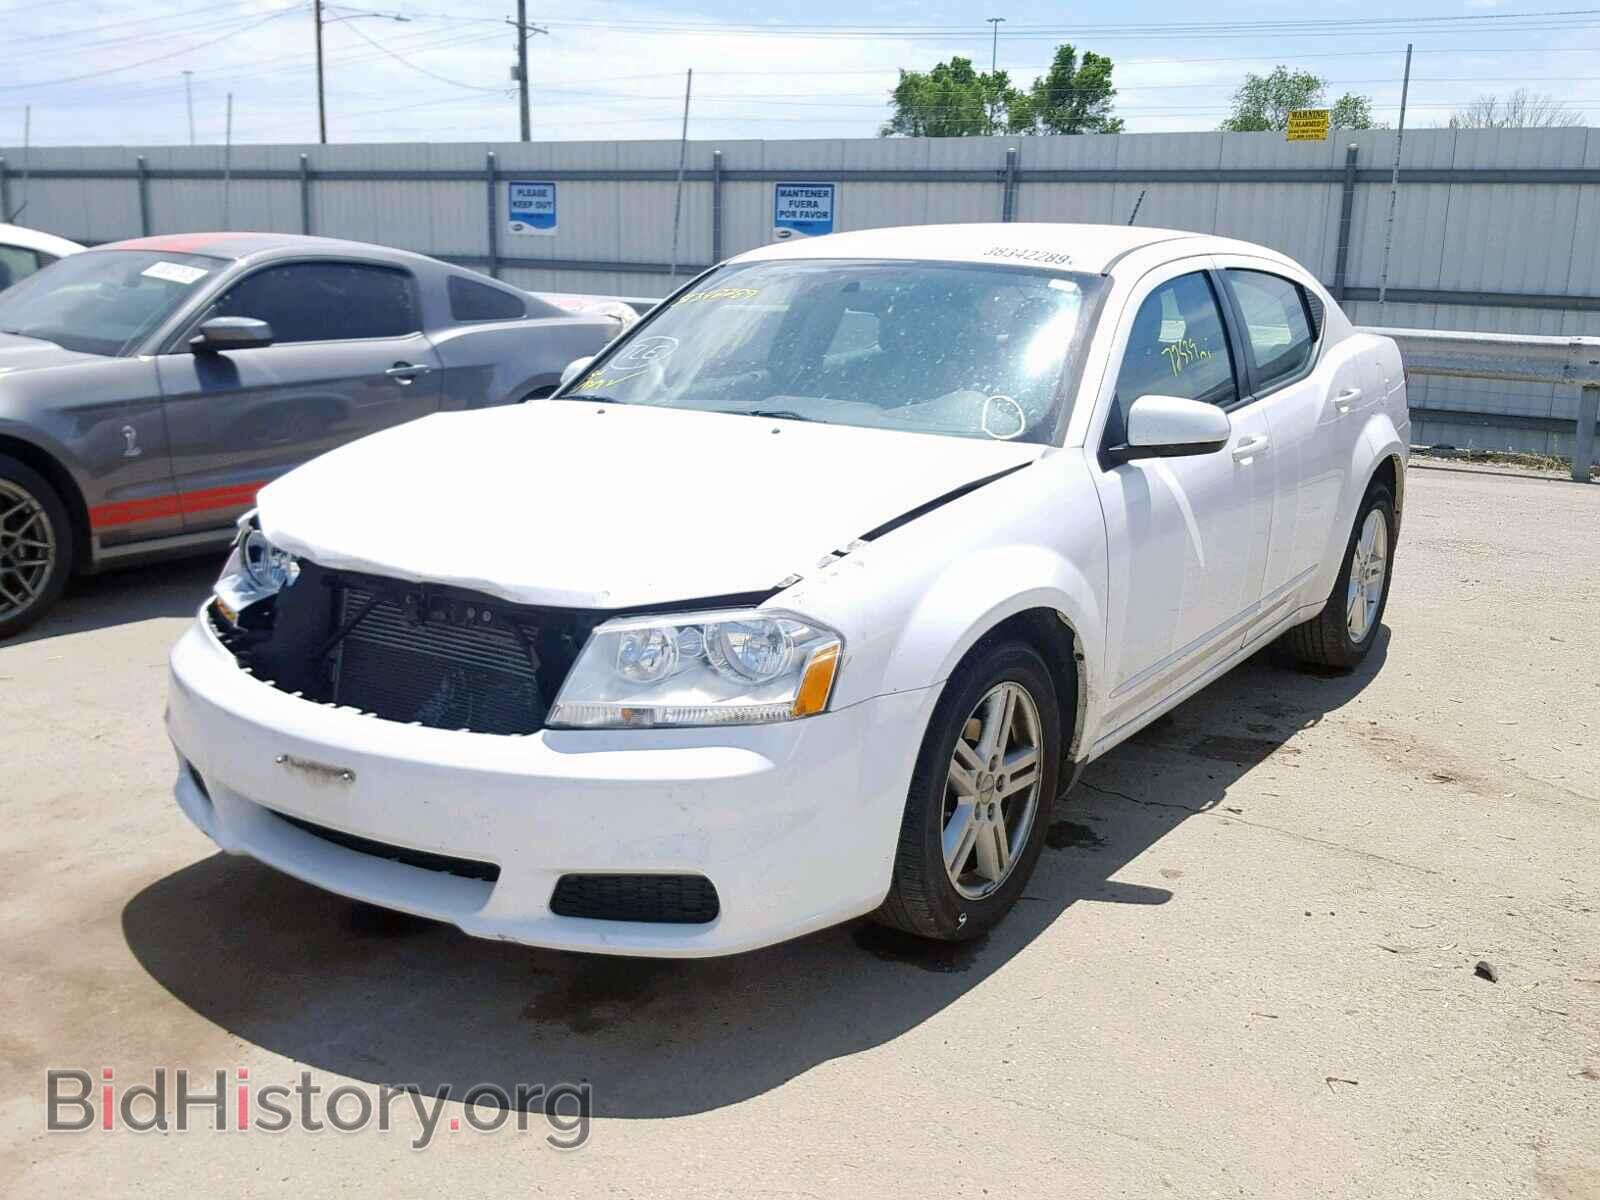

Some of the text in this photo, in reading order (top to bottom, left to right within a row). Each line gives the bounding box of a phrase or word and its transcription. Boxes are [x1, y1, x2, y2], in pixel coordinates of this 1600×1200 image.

[1291, 110, 1328, 119] WARNING
[517, 189, 548, 197] PLEASE
[780, 190, 829, 198] MANTENER
[513, 200, 552, 209] KEEP OUT
[789, 200, 819, 208] FUERA
[779, 210, 829, 218] POR FAVOR
